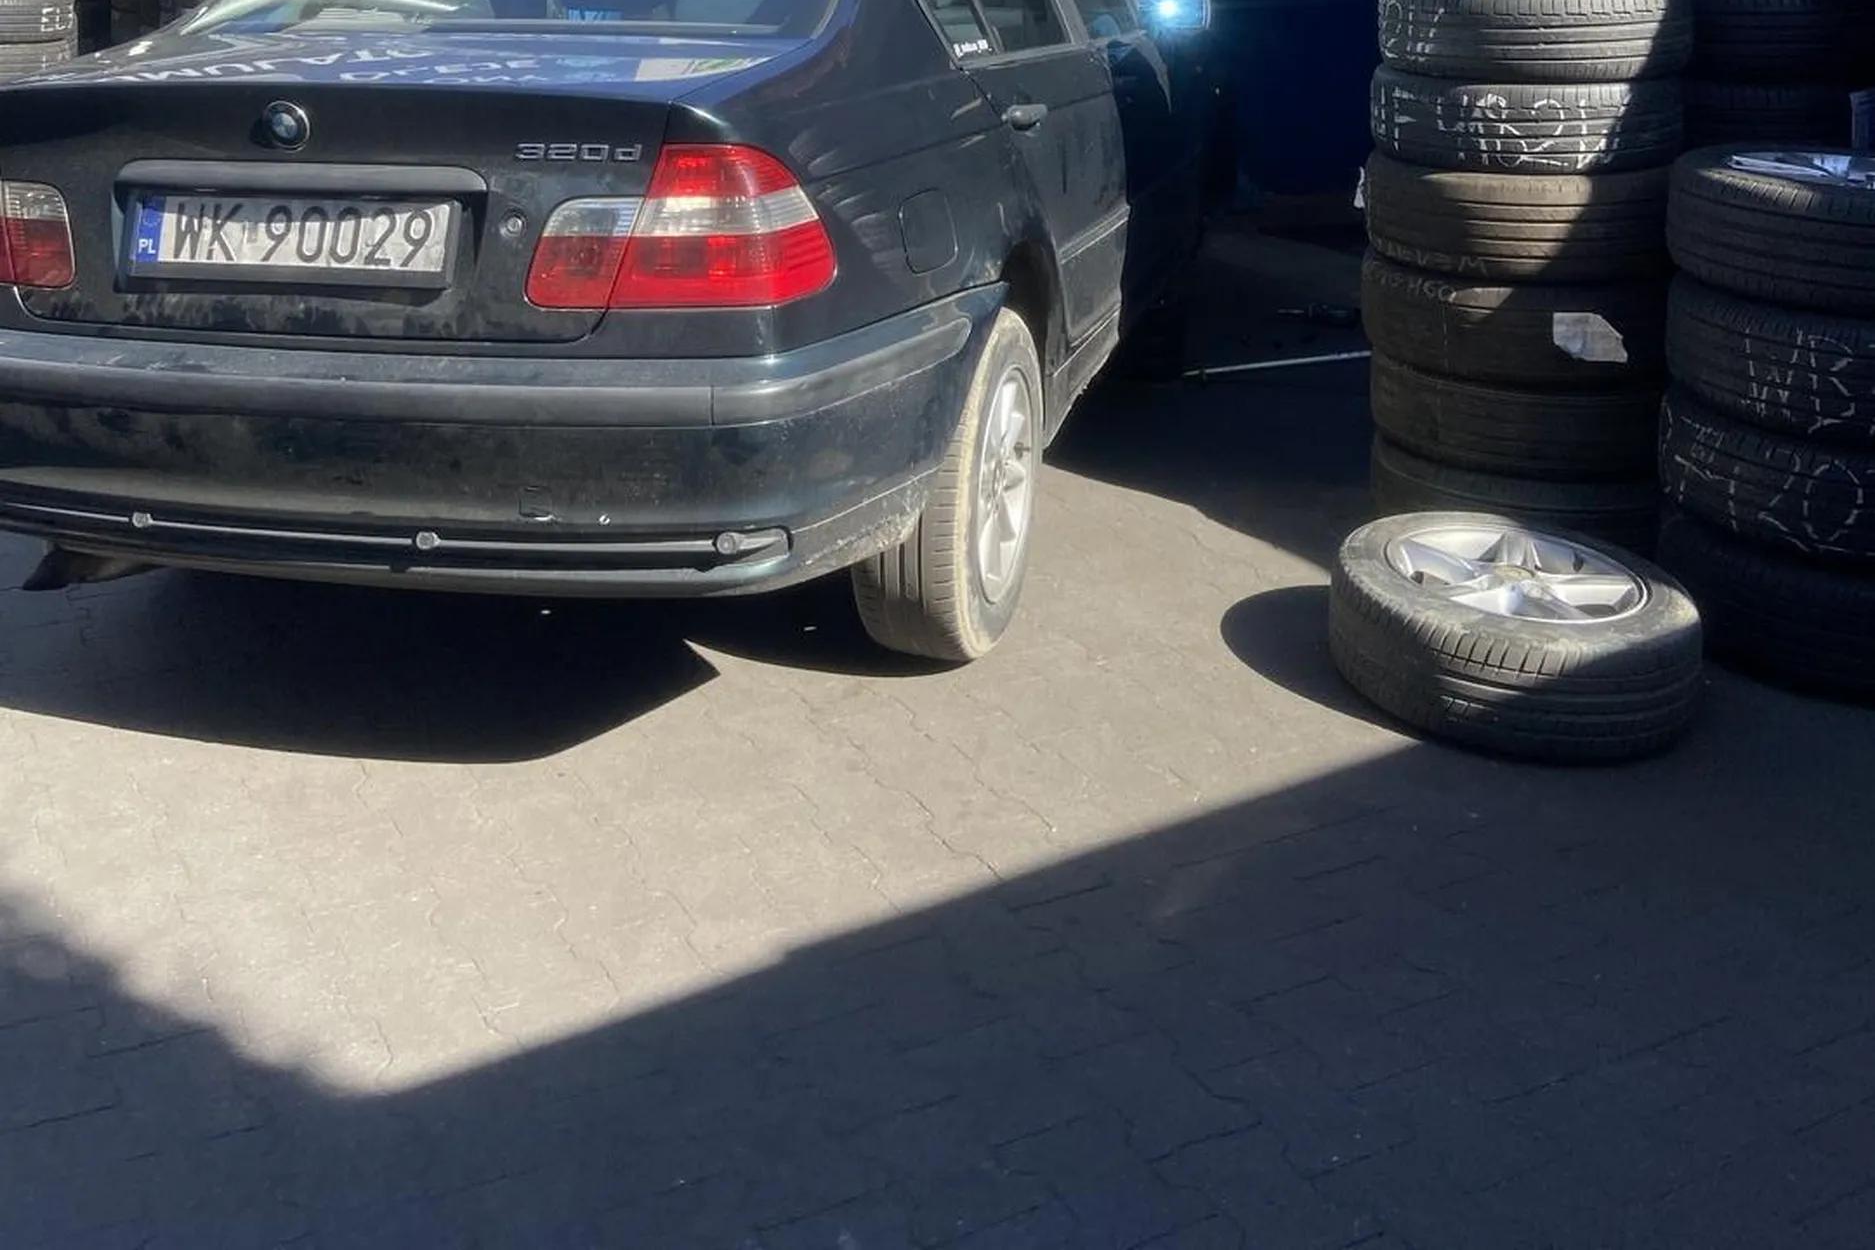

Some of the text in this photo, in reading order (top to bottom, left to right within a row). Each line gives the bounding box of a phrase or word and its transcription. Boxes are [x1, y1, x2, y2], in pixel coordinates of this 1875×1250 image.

[515, 142, 643, 161] 320d
[138, 202, 433, 268] PL WK 90029
